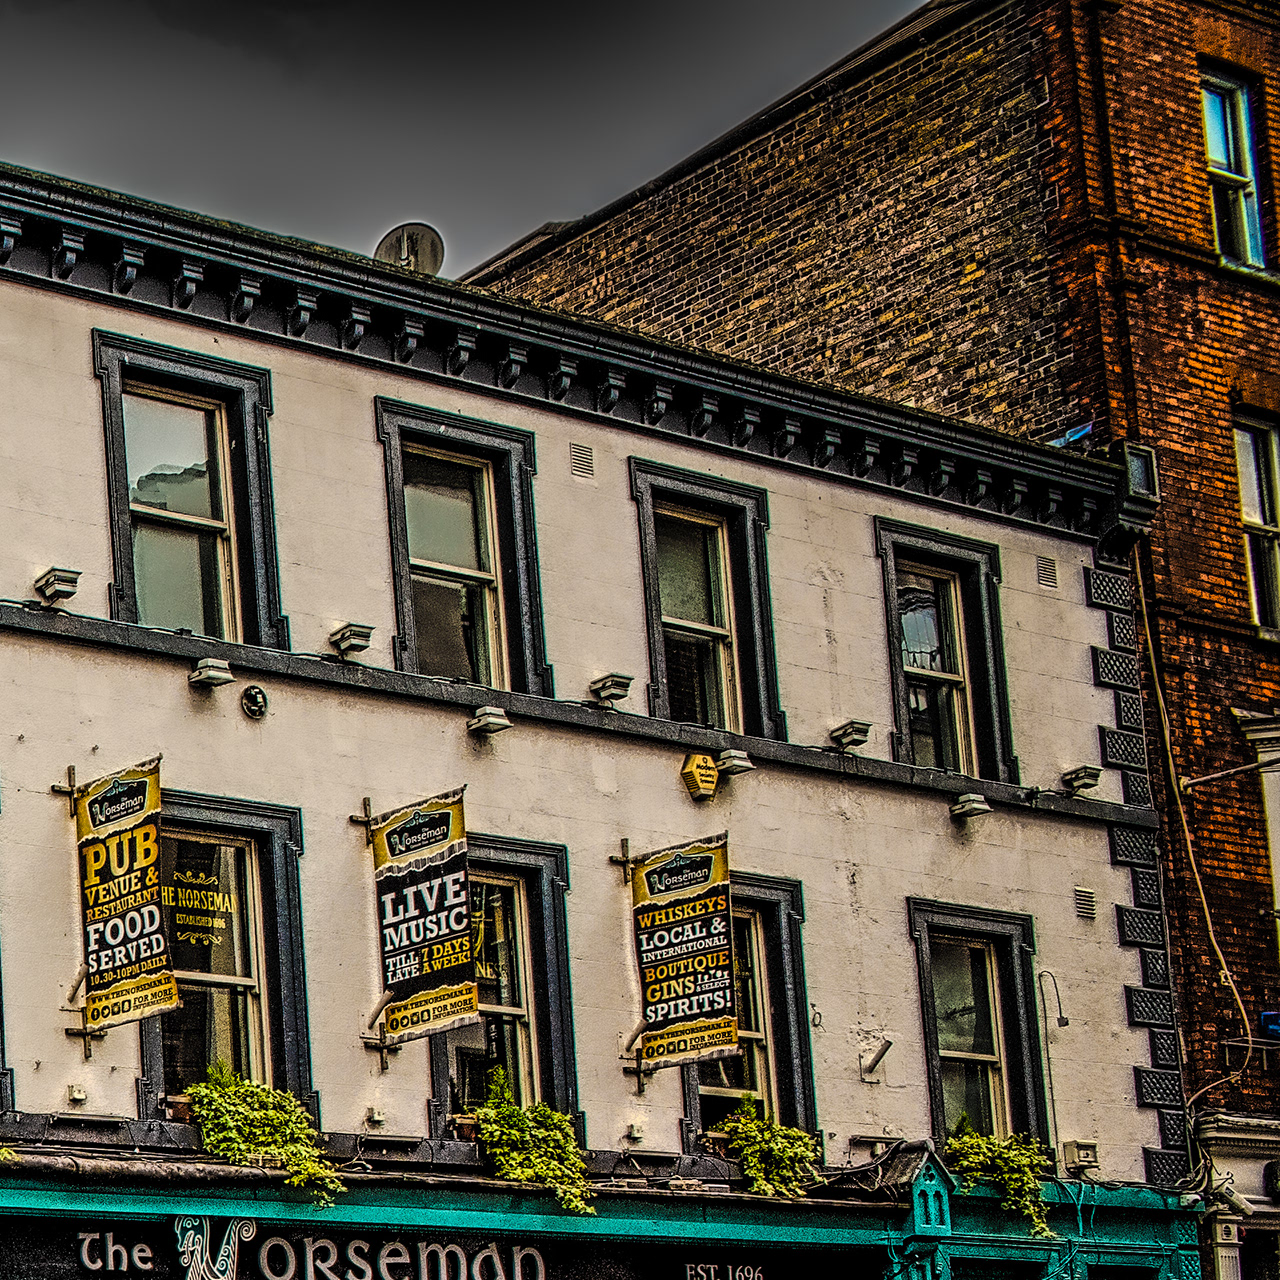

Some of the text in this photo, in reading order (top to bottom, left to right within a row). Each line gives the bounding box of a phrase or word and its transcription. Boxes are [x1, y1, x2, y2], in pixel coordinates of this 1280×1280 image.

[92, 795, 143, 826] Norseman
[391, 826, 447, 853] Norseman
[83, 823, 158, 887] PUB
[85, 867, 159, 906] VENUE &
[650, 868, 708, 892] Norseman
[86, 886, 159, 922] RESTAURANT
[178, 887, 237, 913] NORSEMAN
[381, 870, 467, 926] LIVE
[638, 895, 726, 928] WHISKEYS
[87, 904, 160, 951] FOOD
[176, 913, 212, 927] ESTABLISHED
[384, 905, 468, 951] MUSIC
[641, 917, 726, 950] LOCAL &
[89, 933, 165, 973] SERVED
[386, 951, 418, 971] TILL
[422, 937, 470, 961] 7 DAYS
[422, 962, 431, 974] A
[432, 951, 471, 972] WEEK!
[642, 935, 727, 962] INTERNATIONAL
[91, 955, 167, 985] 10.30-10PM DAILY
[386, 965, 419, 984] LATE
[645, 951, 729, 982] BOUTIQUE
[91, 976, 172, 1005] WWW.THENORSEMAN.IE
[133, 988, 173, 1005] FOR MORE
[646, 976, 694, 1002] GINS
[702, 979, 730, 991] SELECT
[432, 998, 473, 1014] FOR MORE
[646, 990, 731, 1022] SPIRITS!
[645, 1020, 732, 1043] WWW.THENORSEMAN.IE
[689, 1031, 732, 1044] FOR MORE
[77, 1231, 154, 1272] The
